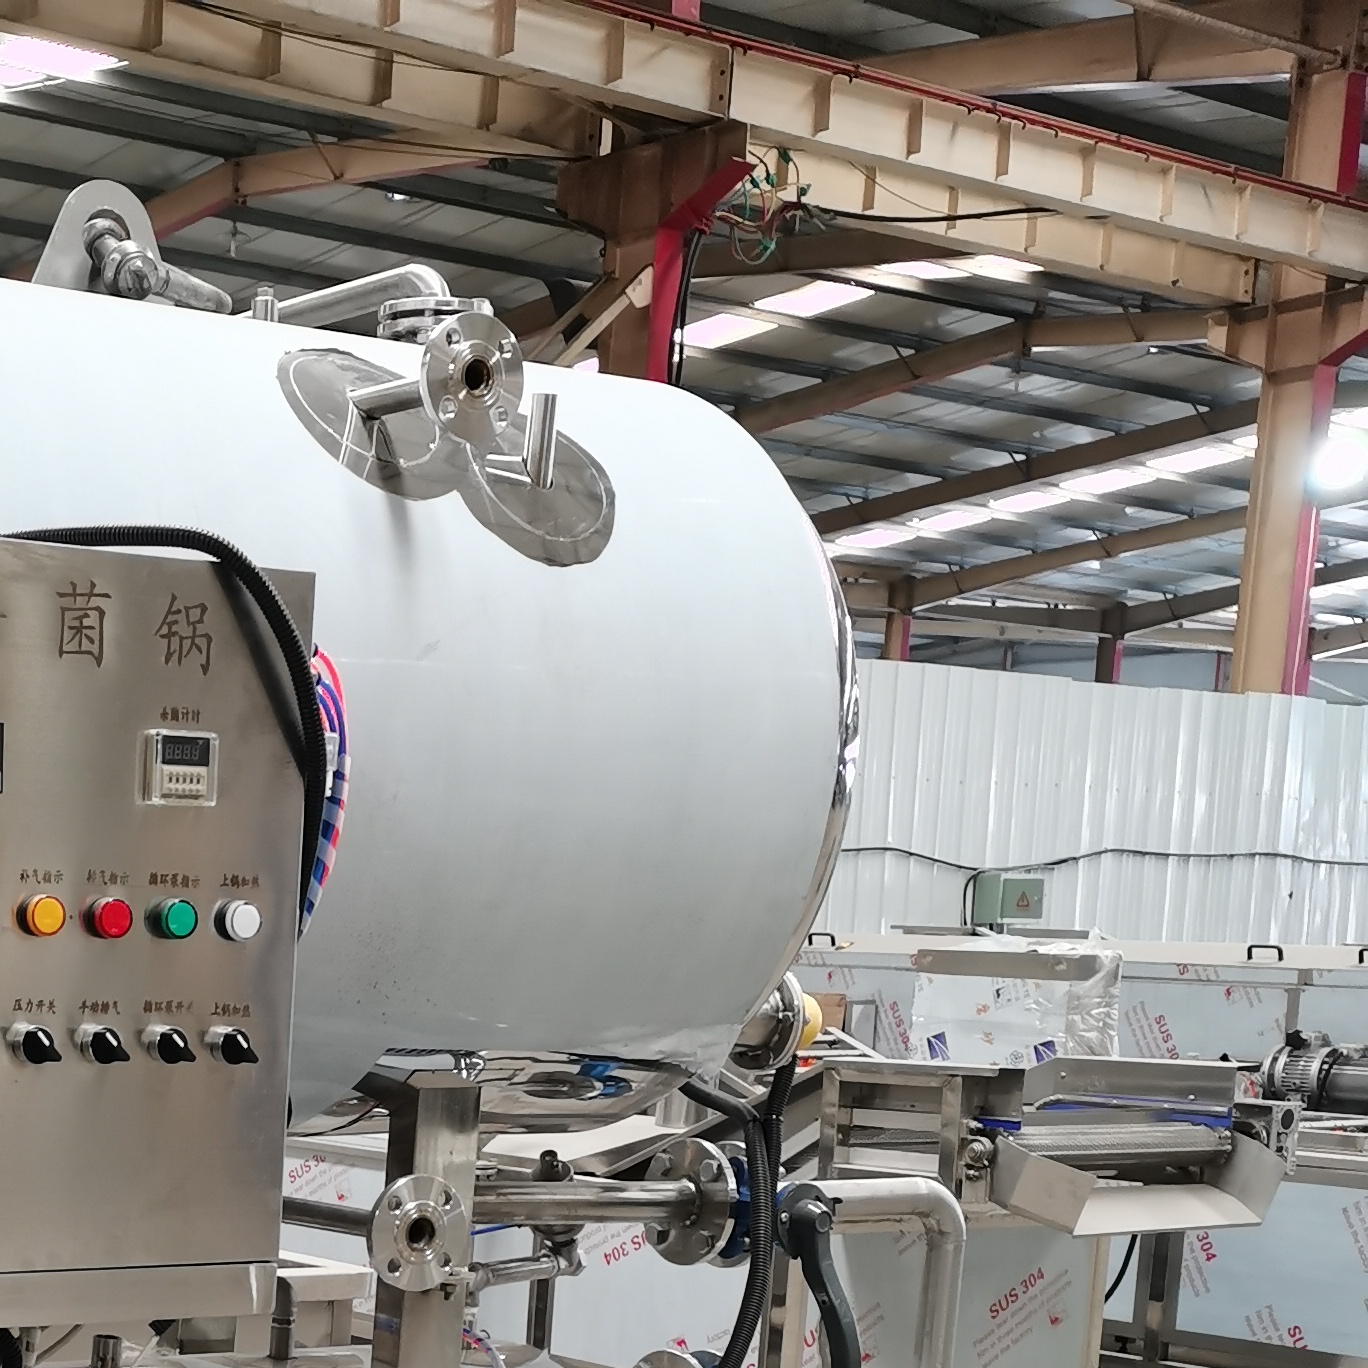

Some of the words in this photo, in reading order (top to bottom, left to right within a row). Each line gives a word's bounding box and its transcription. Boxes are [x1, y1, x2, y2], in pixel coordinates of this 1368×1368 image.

[12, 998, 57, 1015] 压力开关
[1154, 1014, 1173, 1044] SUS
[288, 1159, 312, 1184] SUS
[603, 1241, 630, 1265] 304
[1196, 1231, 1218, 1263] 304
[989, 1287, 1019, 1319] SUS
[1020, 1267, 1044, 1294] 304
